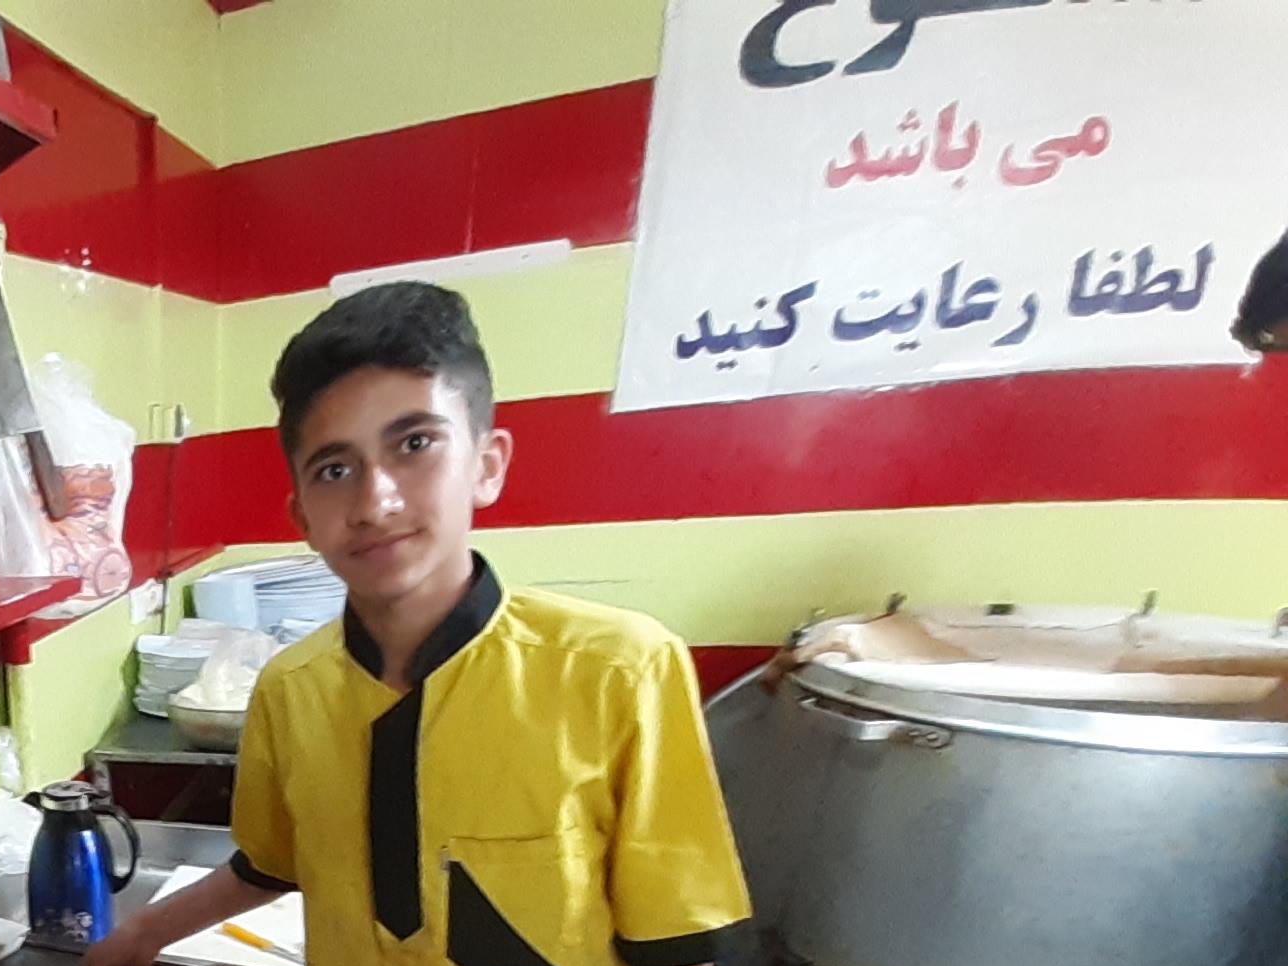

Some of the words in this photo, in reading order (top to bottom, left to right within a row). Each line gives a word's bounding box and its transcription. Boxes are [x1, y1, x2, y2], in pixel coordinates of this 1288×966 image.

[824, 101, 981, 190] باشد
[999, 115, 1111, 186] می
[832, 261, 1039, 352] رعایت
[1068, 242, 1214, 318] لطفا
[675, 281, 817, 371] کنید
